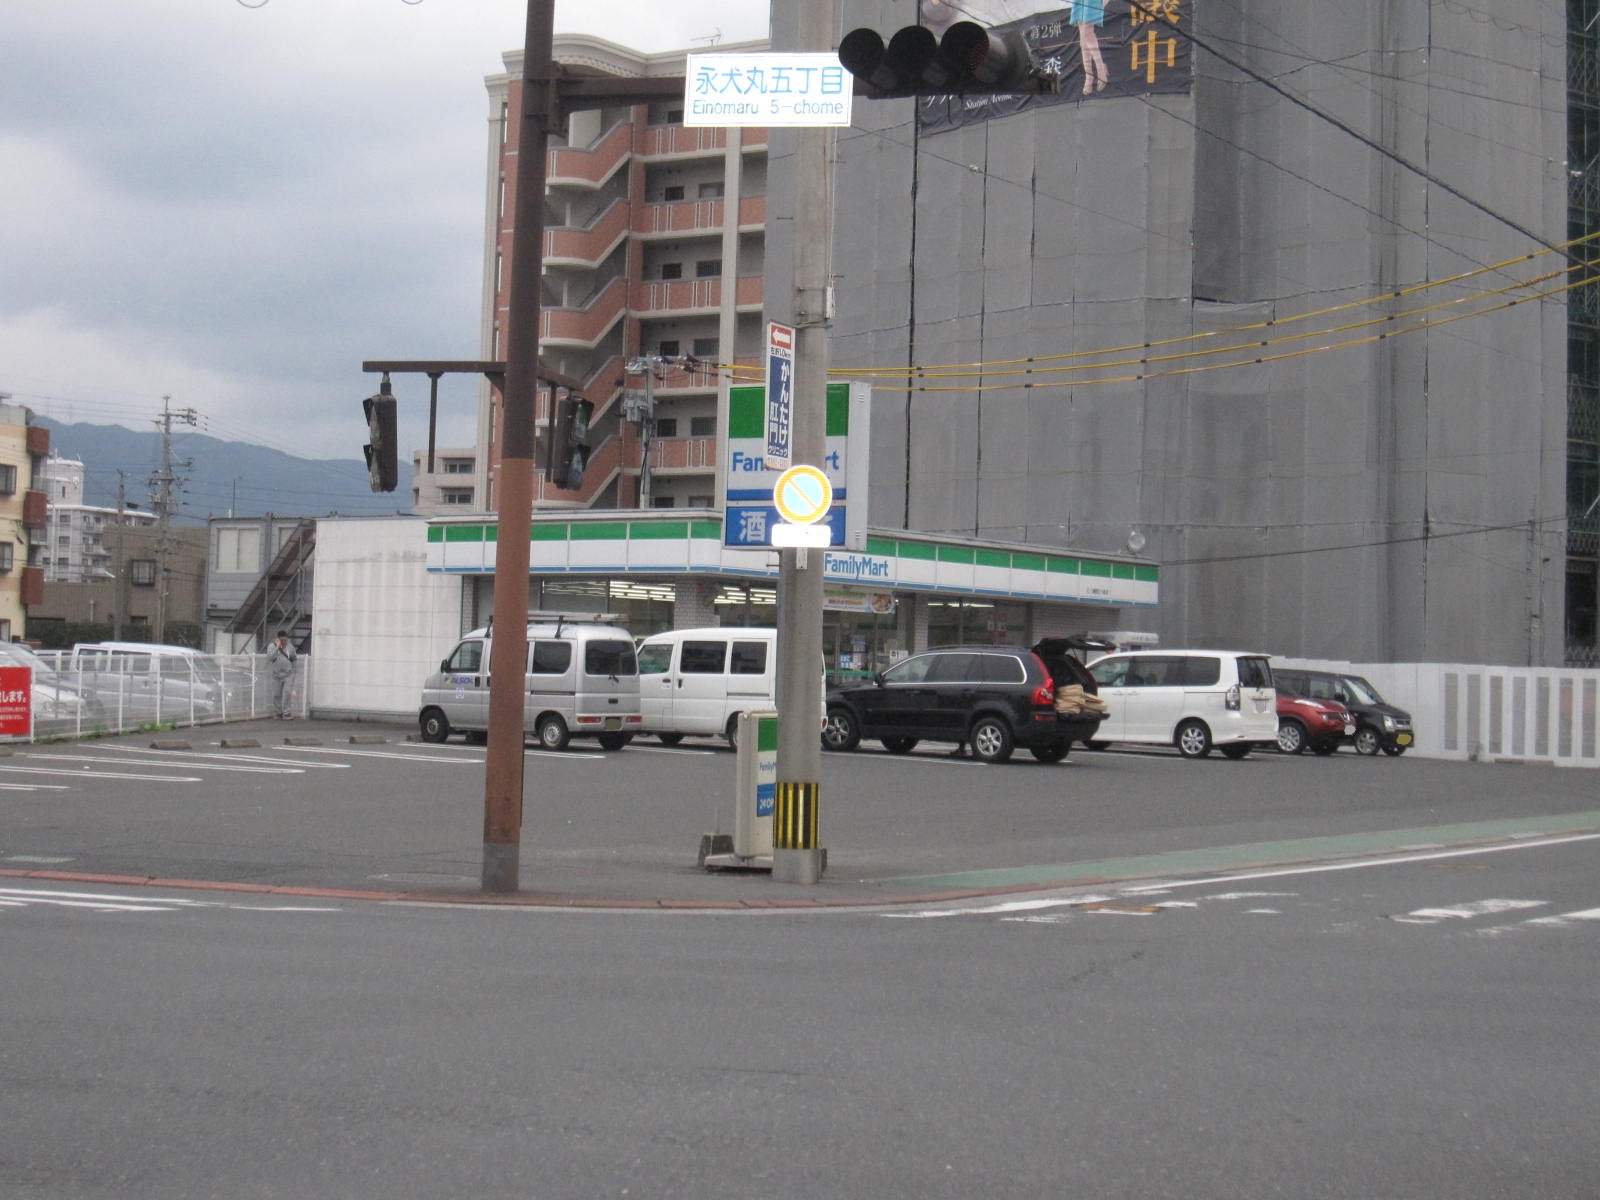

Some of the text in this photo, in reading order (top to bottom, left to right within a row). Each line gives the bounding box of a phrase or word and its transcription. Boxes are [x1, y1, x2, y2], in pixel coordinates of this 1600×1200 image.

[695, 66, 843, 95] 永犬丸五丁目
[692, 99, 759, 115] Einomaru
[769, 401, 779, 444] 肛門
[739, 510, 767, 542] 酒
[824, 553, 889, 579] FamilyMart
